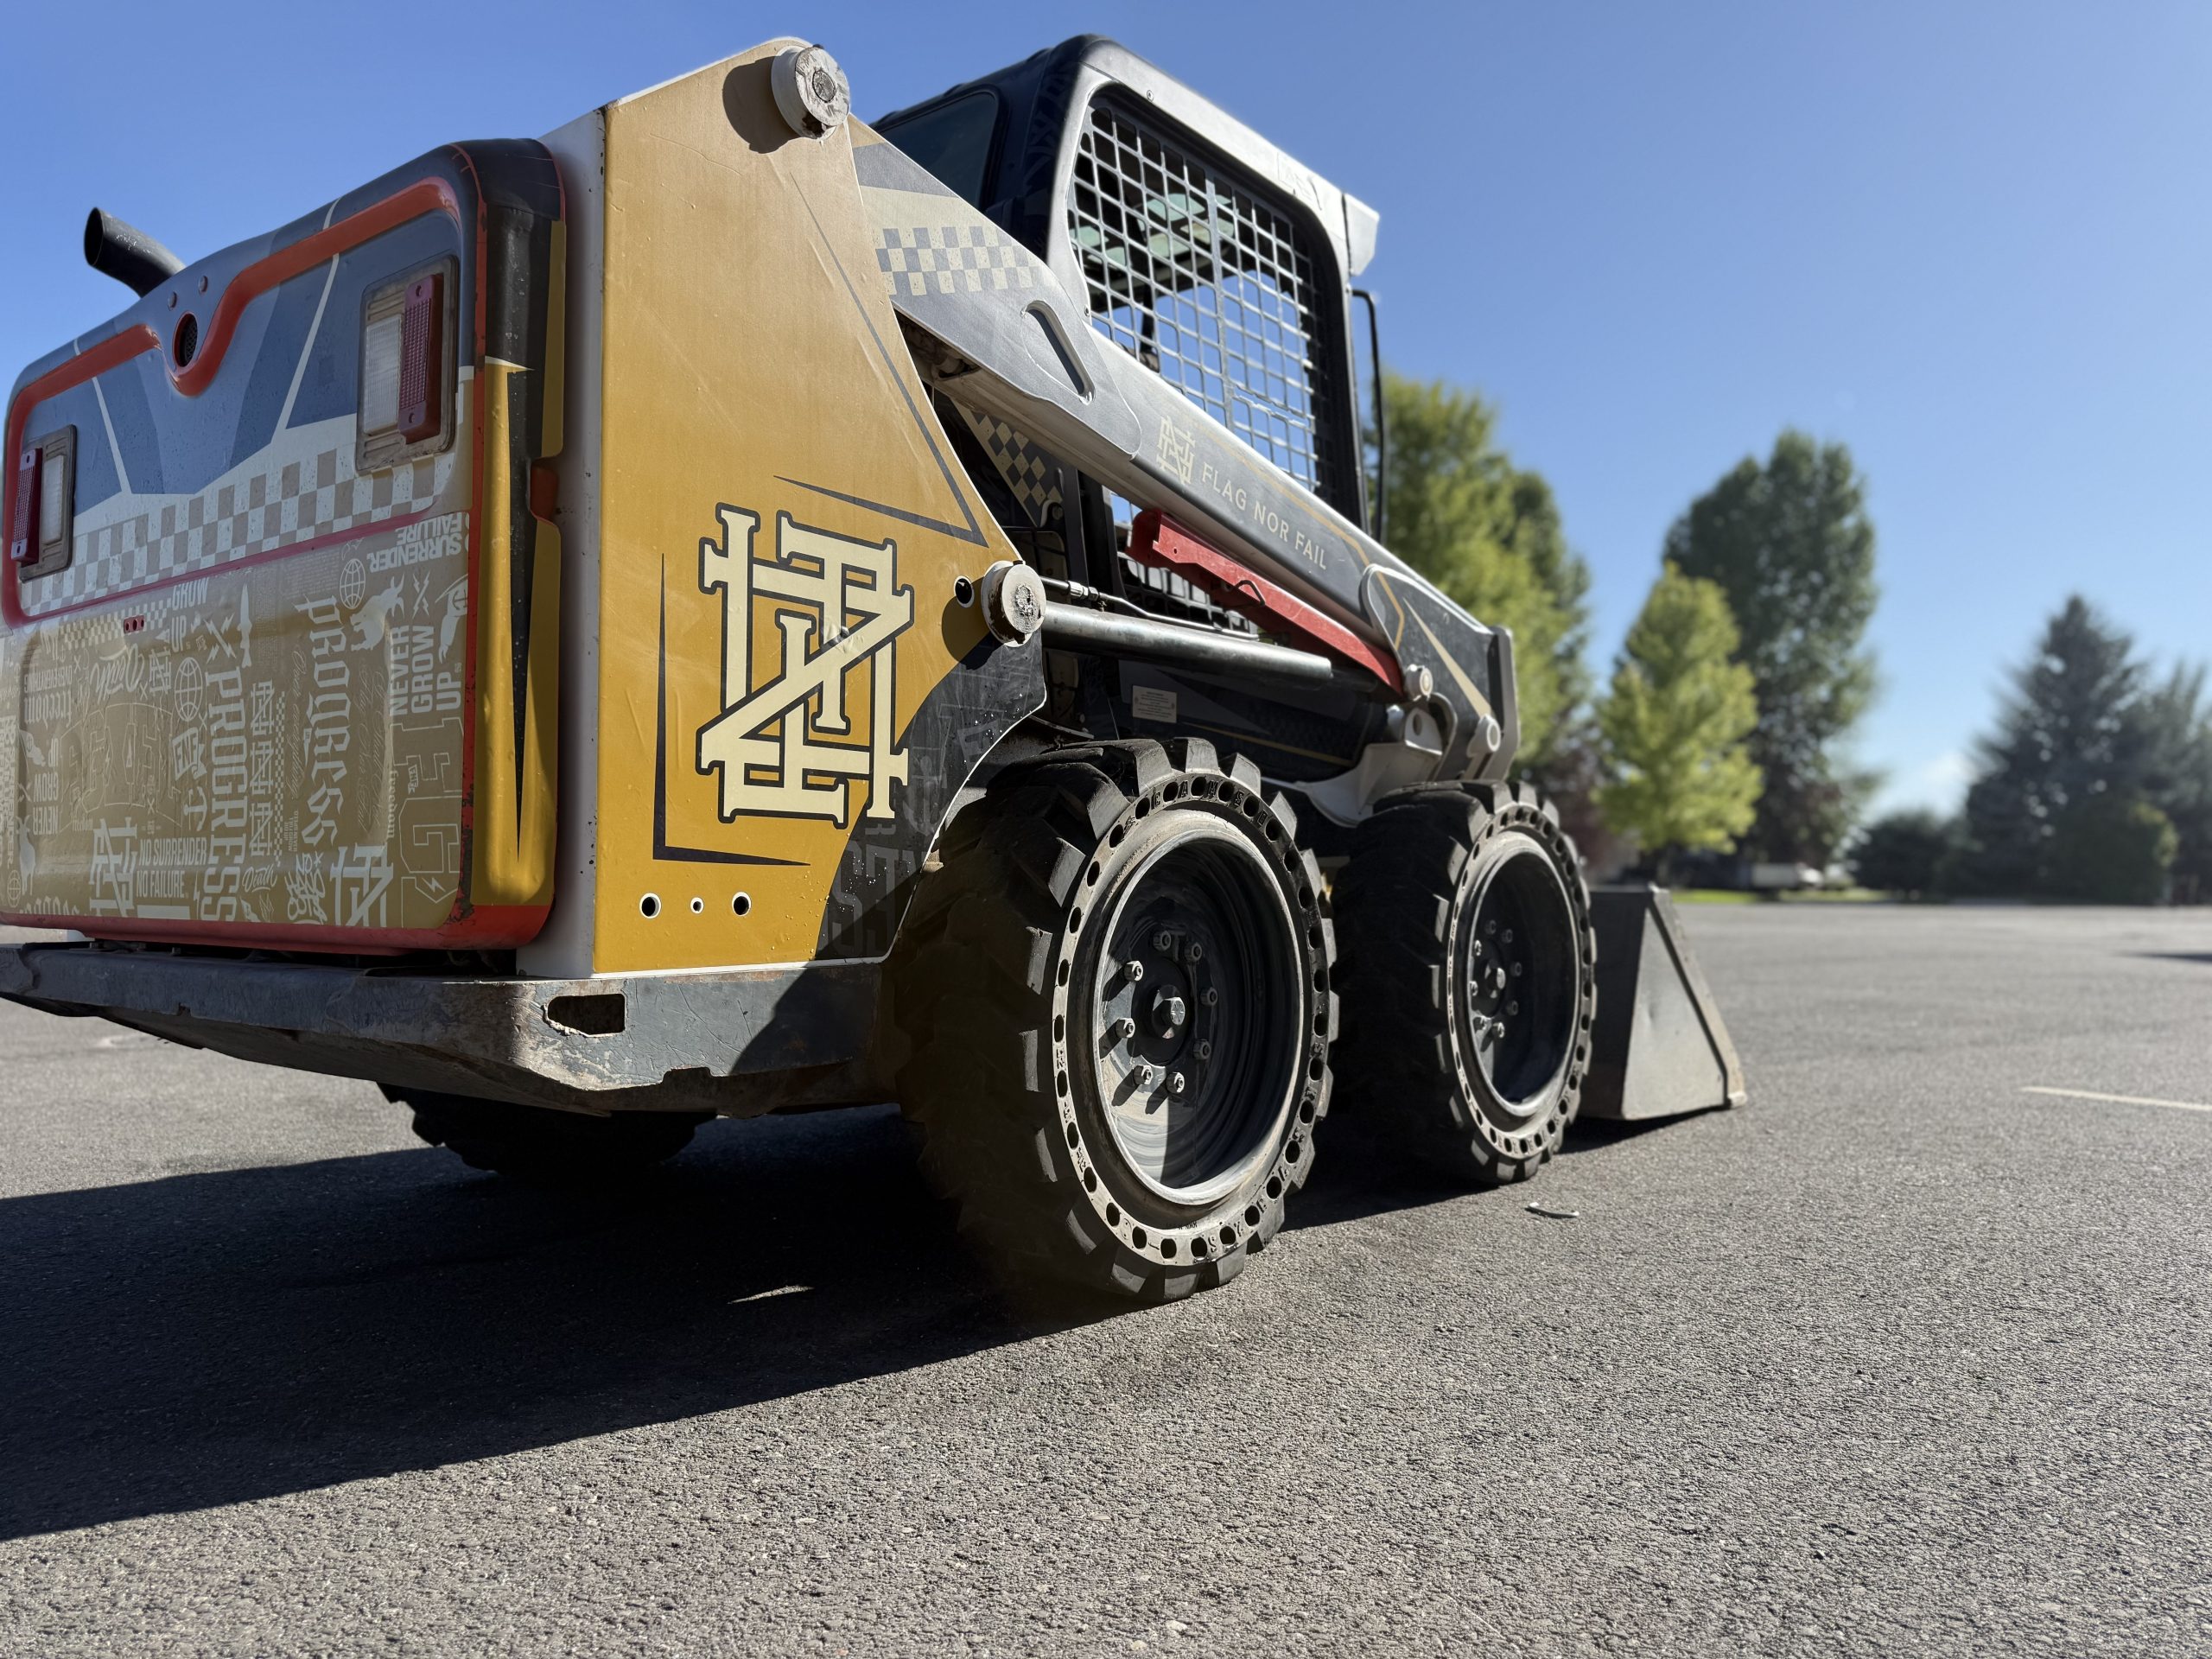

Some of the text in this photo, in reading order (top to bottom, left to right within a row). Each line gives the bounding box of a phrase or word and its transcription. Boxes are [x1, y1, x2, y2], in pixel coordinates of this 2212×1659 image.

[1202, 461, 1248, 511] FLAG
[1254, 500, 1289, 543] NOR
[1295, 530, 1327, 570] FAIL
[173, 577, 209, 611] GROW
[389, 625, 410, 717] NEVER
[410, 625, 435, 714] GROW
[435, 671, 462, 711] UP
[200, 665, 248, 922] PROGRESS
[138, 836, 207, 867] NO SURRENDER
[136, 870, 149, 898] NO
